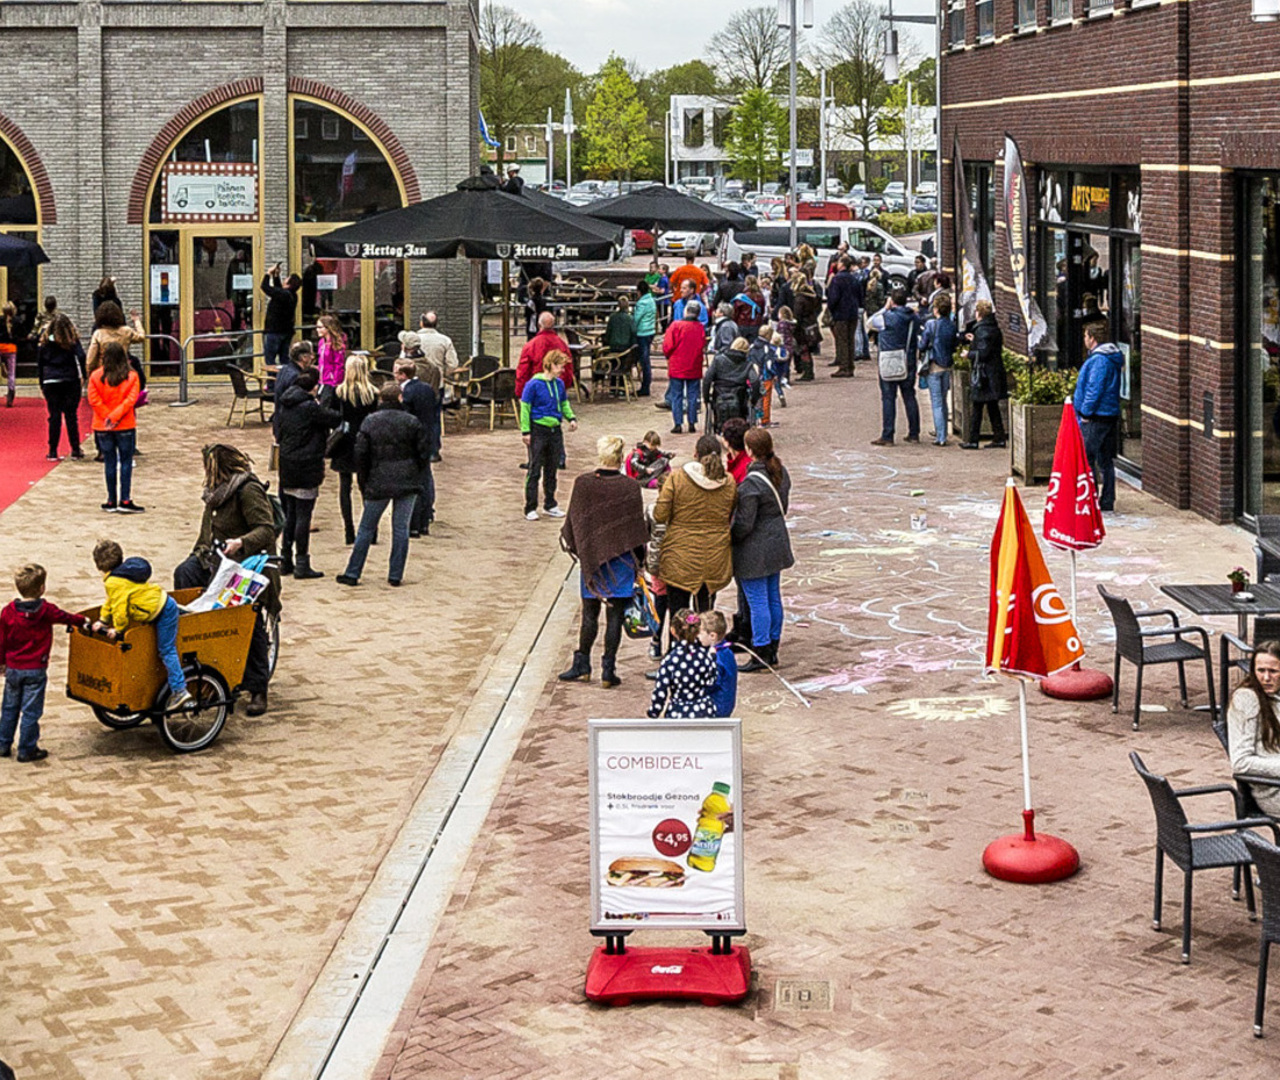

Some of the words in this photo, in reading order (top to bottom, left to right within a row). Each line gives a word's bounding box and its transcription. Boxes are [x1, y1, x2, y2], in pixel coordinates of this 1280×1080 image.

[1071, 185, 1091, 212] ARTS
[362, 243, 403, 258] Hertog
[404, 243, 427, 258] Jan
[513, 243, 556, 259] Hertog
[556, 243, 579, 259] Jan
[606, 756, 704, 770] COMBIDEAL
[606, 792, 663, 801] Stokbroodje
[664, 792, 700, 801] Gezond
